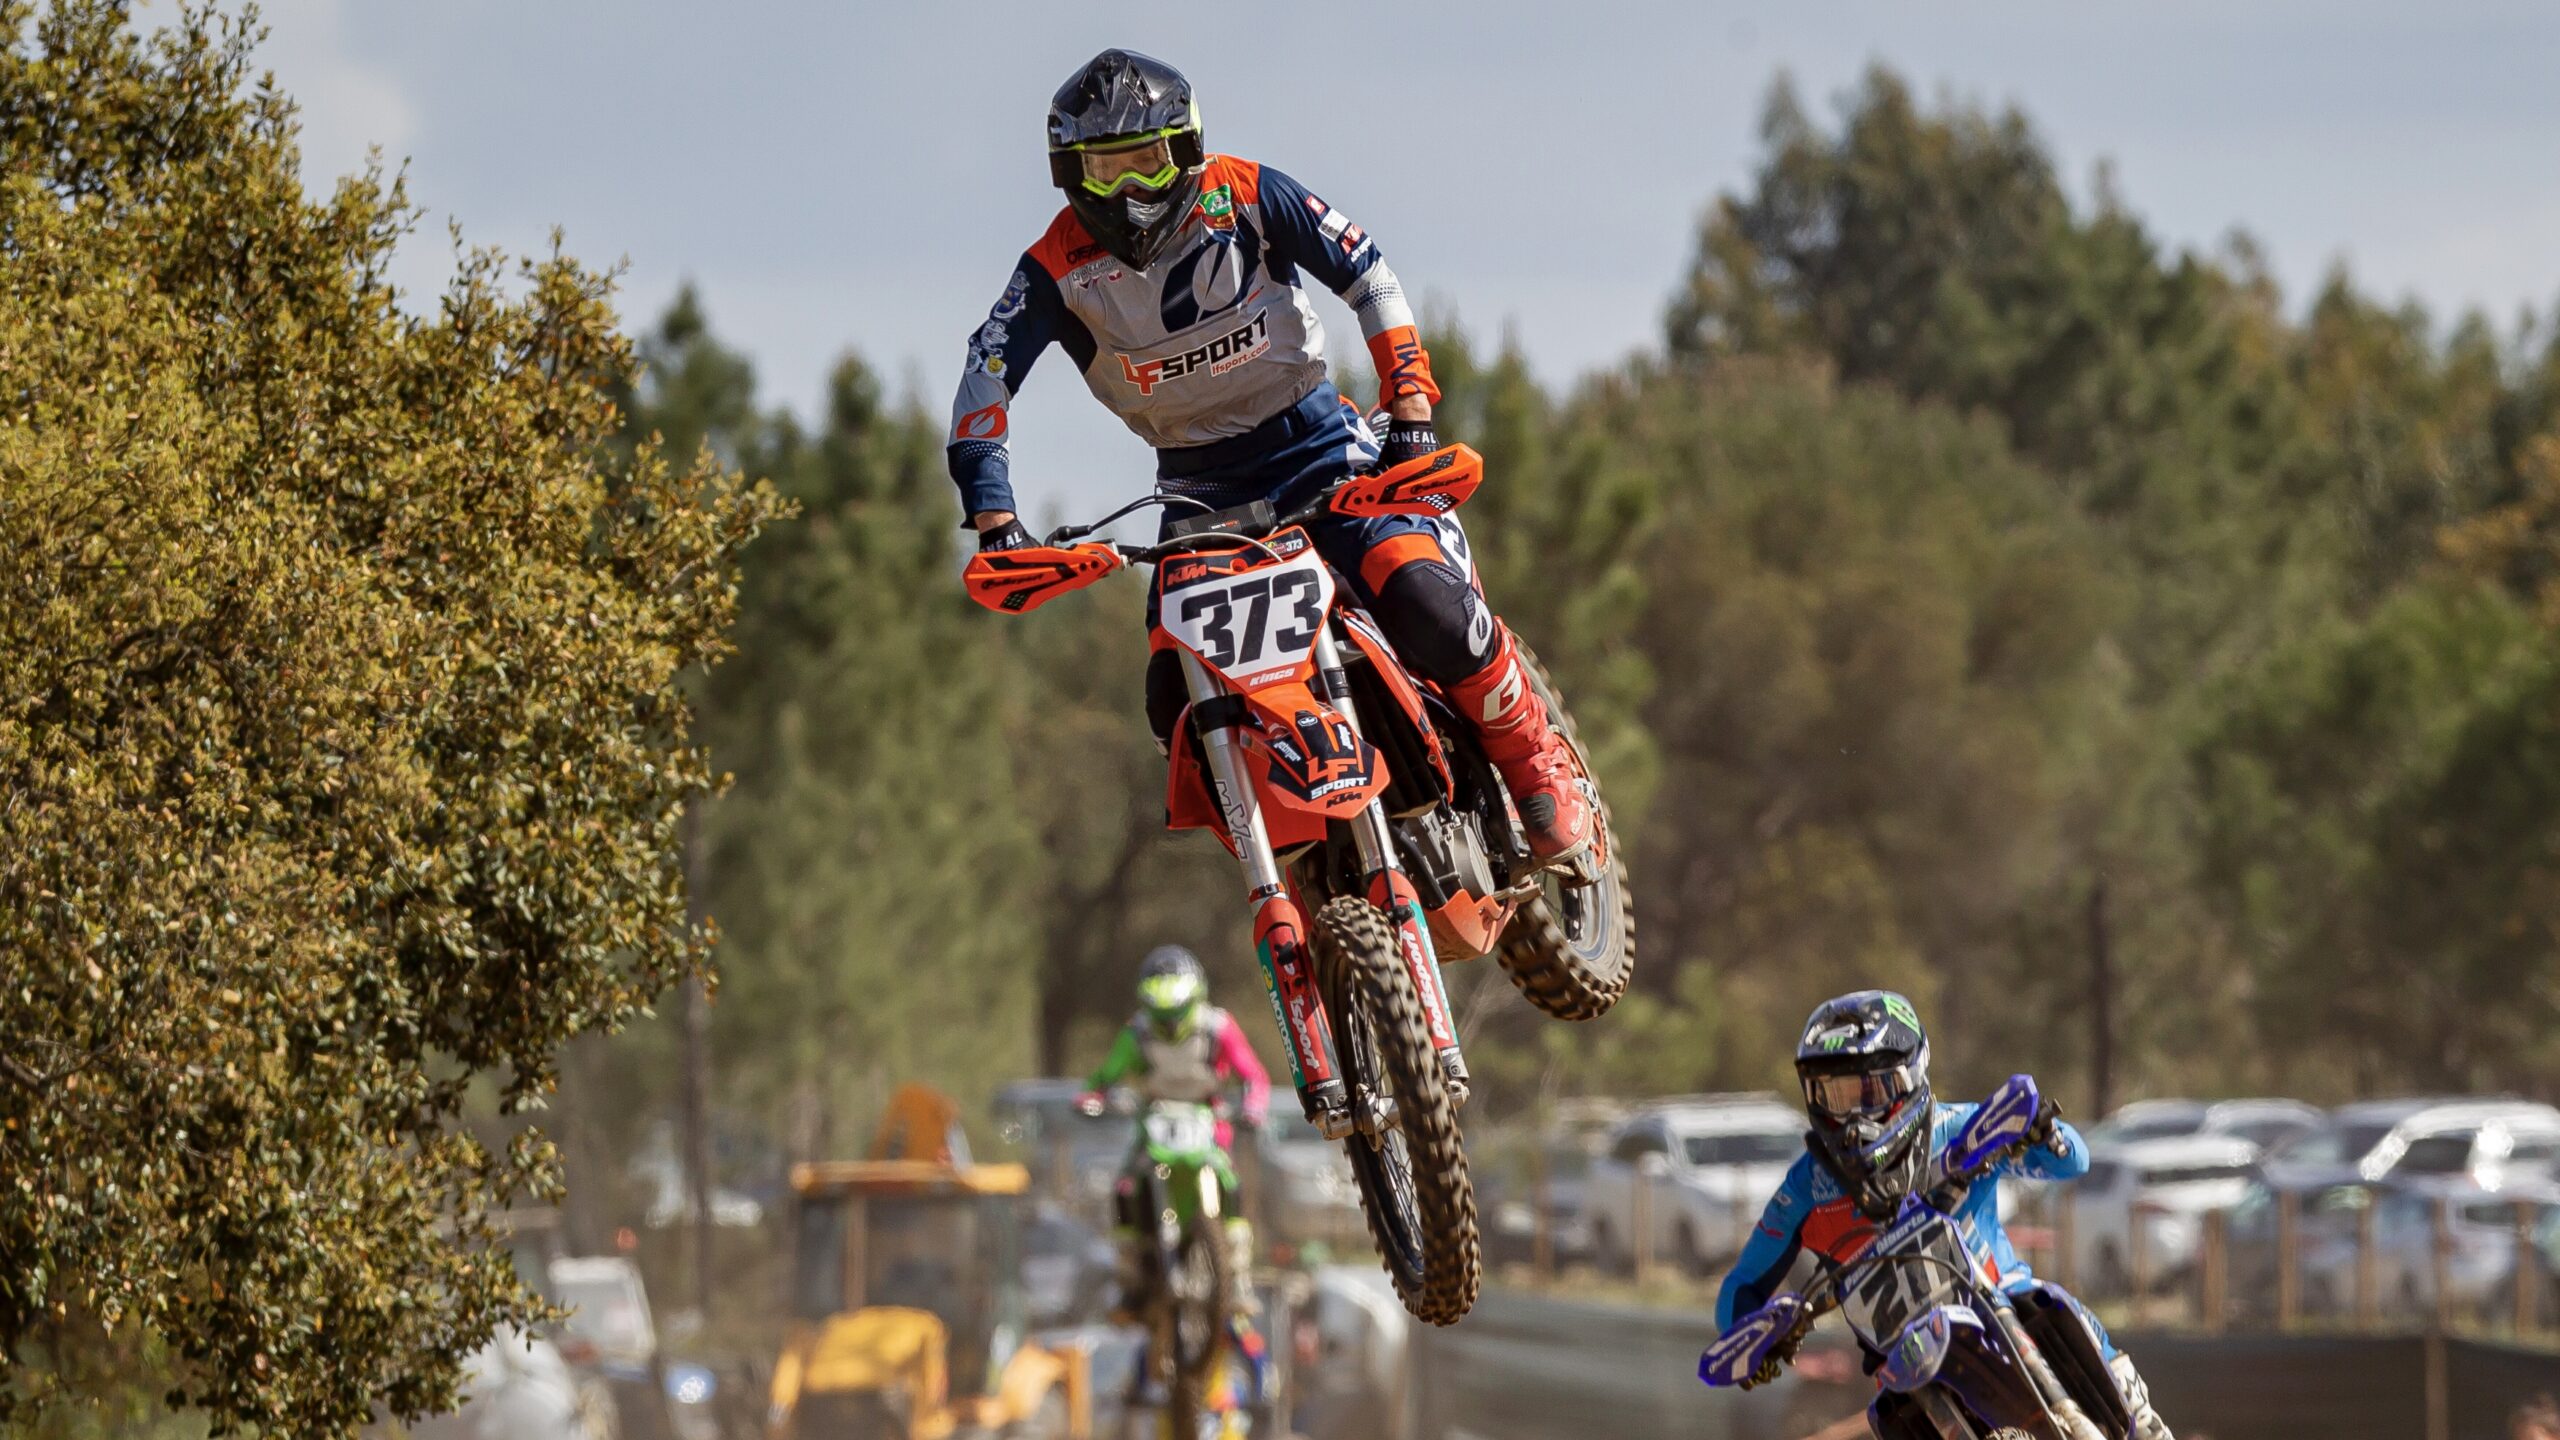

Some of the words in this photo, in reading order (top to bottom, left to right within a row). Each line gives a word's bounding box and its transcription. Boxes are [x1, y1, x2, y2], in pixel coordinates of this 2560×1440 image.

[1212, 340, 1269, 375] lfsport.com
[1390, 431, 1437, 444] ONEAL
[1286, 538, 1304, 552] 373
[1167, 563, 1207, 586] KTM
[1181, 568, 1322, 669] 373
[1311, 777, 1367, 800] SPORT
[1326, 792, 1362, 809] KTM
[1401, 929, 1450, 1041] Polisport
[1269, 991, 1299, 1074] MOTOREX
